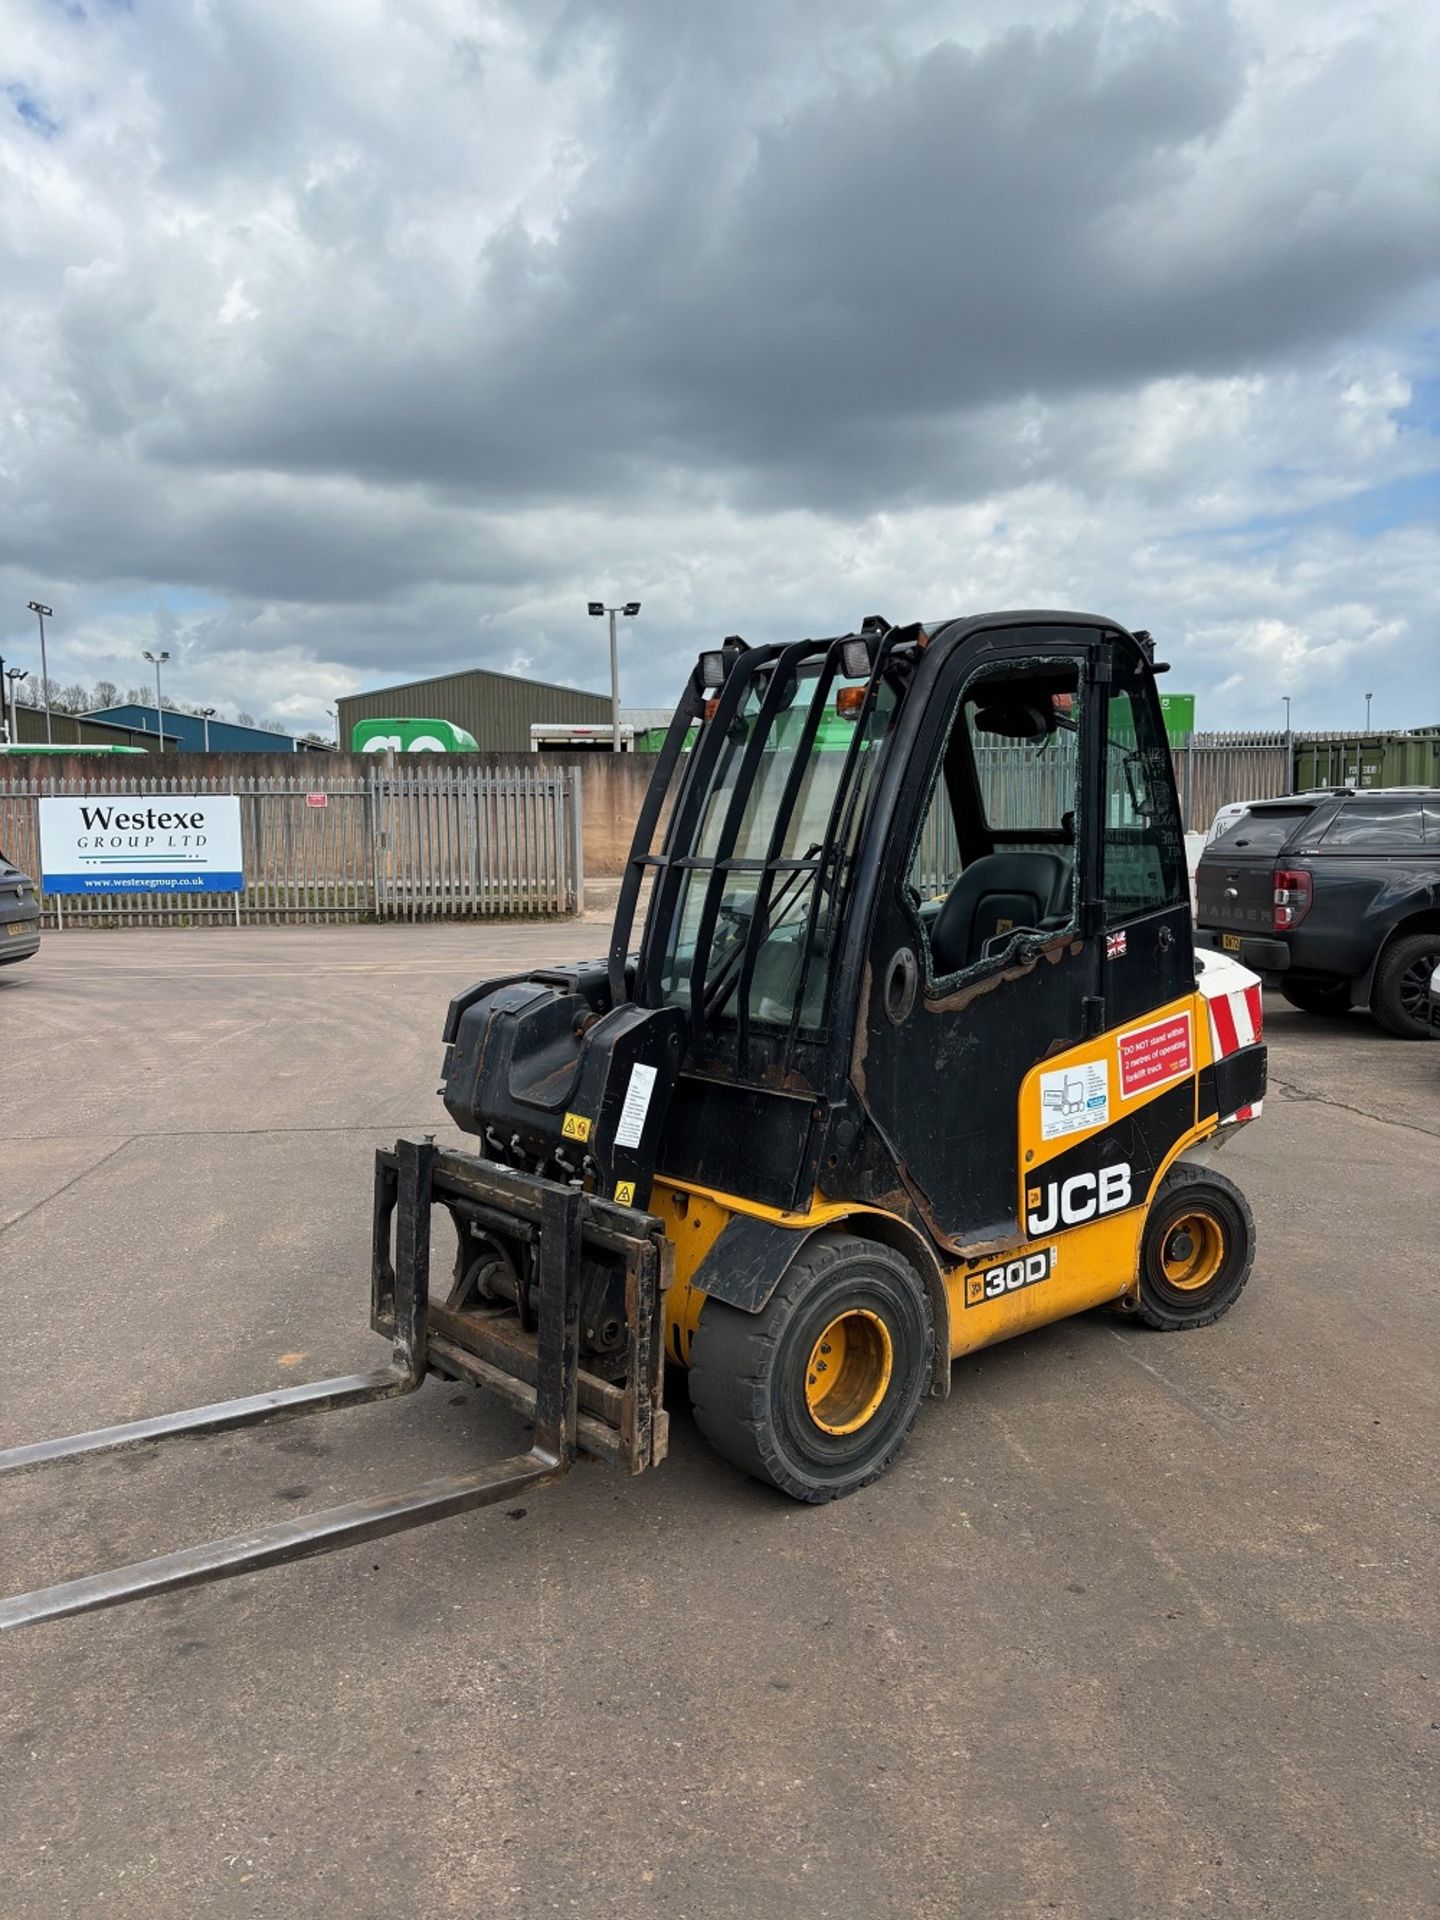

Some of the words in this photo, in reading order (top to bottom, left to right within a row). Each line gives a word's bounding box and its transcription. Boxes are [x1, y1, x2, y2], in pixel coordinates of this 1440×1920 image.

[79, 806, 205, 831] Westexe
[77, 836, 155, 849] GROUP
[168, 834, 208, 847] LTD
[84, 877, 205, 888] www.westexegroup.co.uk
[1124, 1046, 1134, 1056] DO
[1135, 1040, 1149, 1051] NOT
[1150, 1033, 1166, 1045] stand
[1167, 1027, 1185, 1039] within
[1125, 1061, 1130, 1070] 2
[1130, 1055, 1151, 1068] metres
[1151, 1050, 1159, 1059] of
[1159, 1041, 1187, 1056] operating
[1126, 1069, 1146, 1083] forklift
[1147, 1064, 1163, 1075] truck
[1028, 1163, 1131, 1235] JCB
[985, 1254, 1047, 1298] 30D
